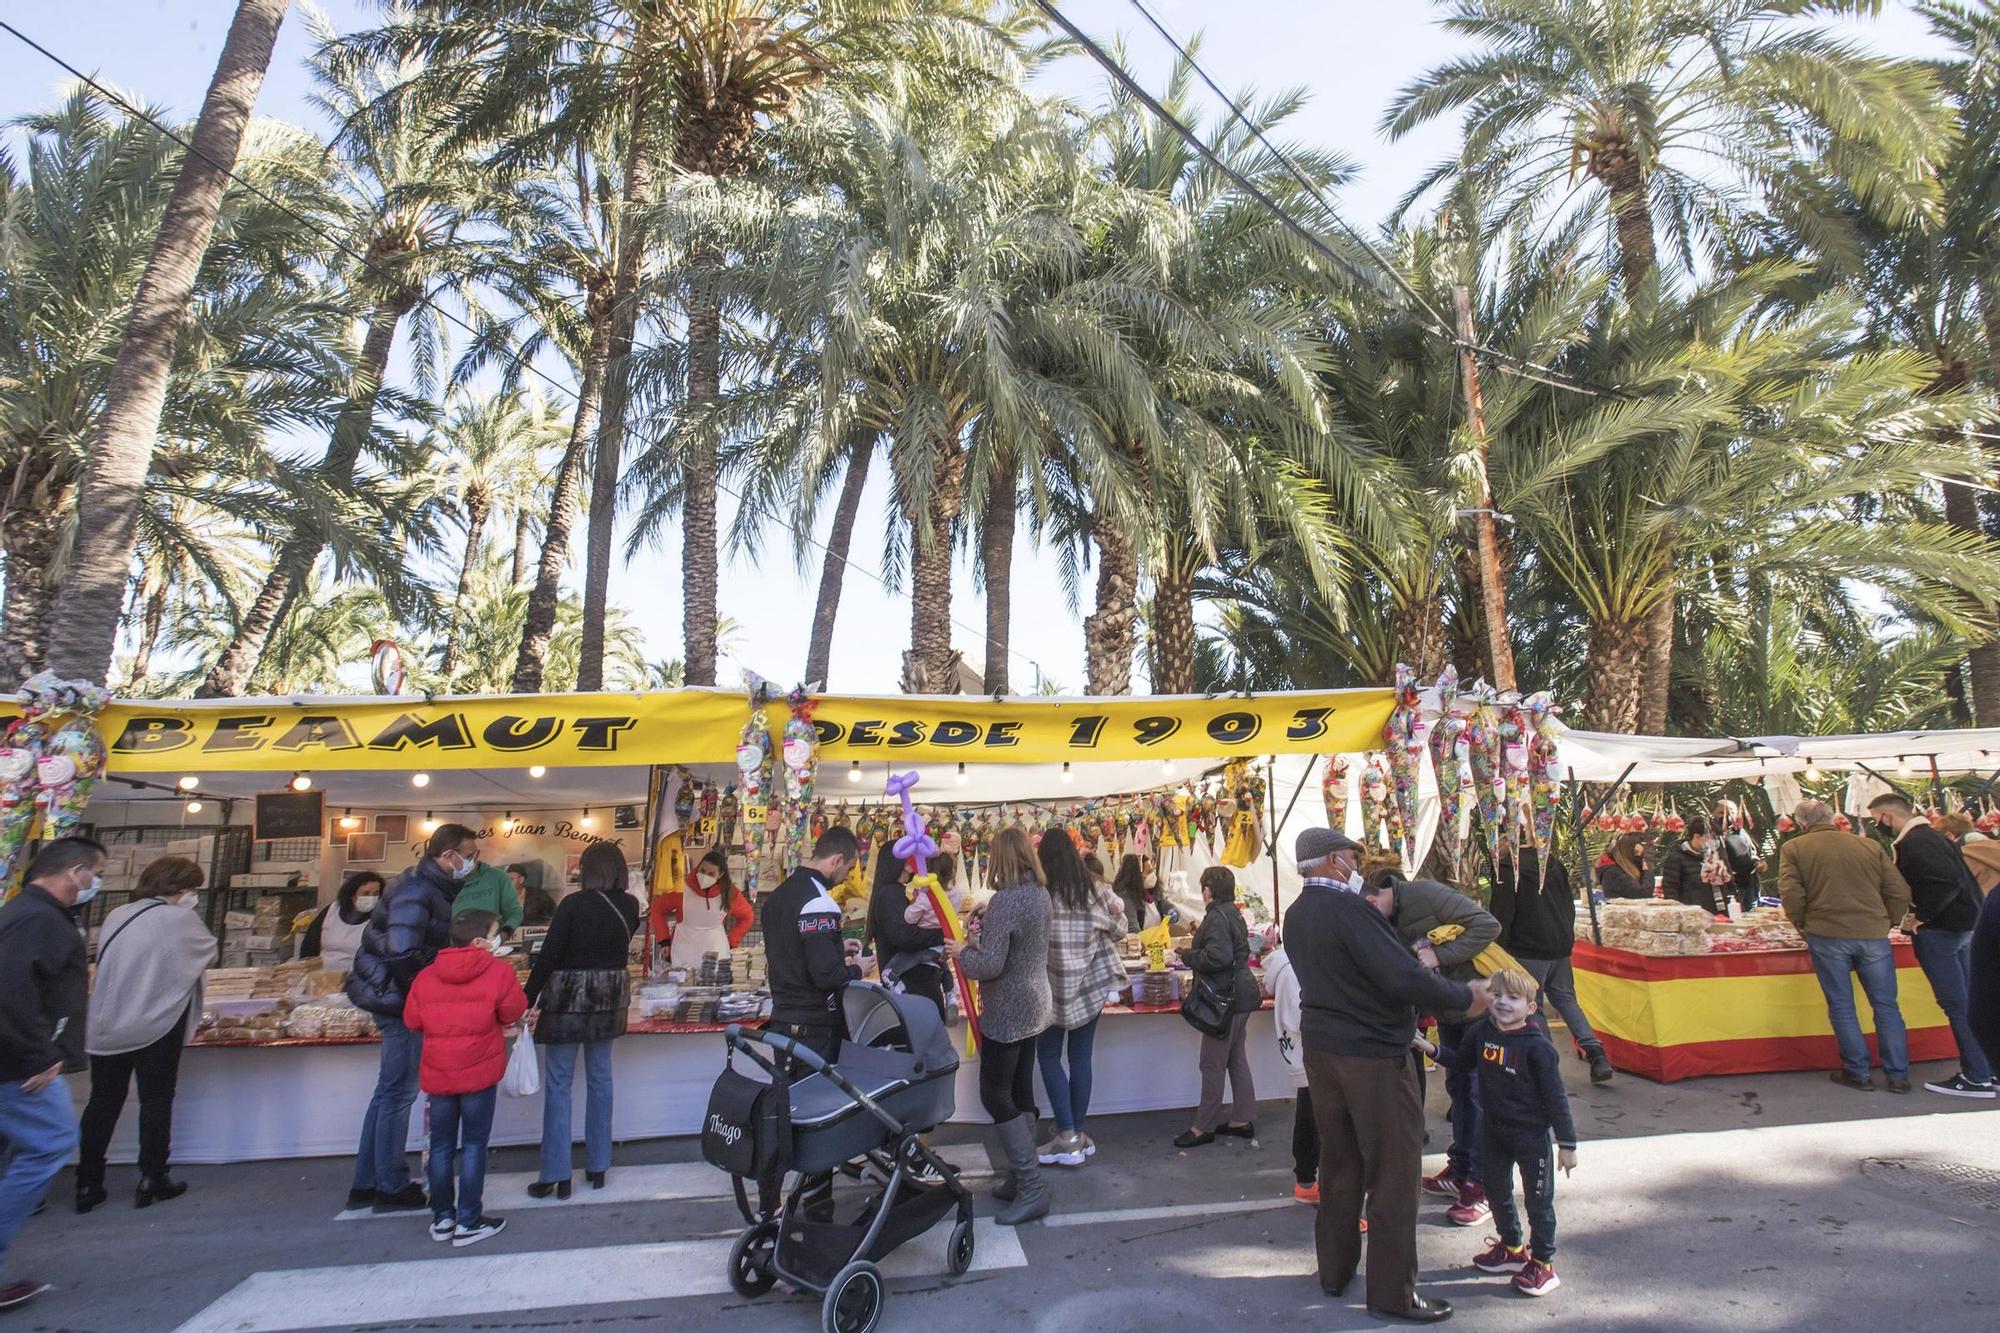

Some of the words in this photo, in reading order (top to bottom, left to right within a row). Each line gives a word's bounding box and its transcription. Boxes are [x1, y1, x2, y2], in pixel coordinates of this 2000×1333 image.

[112, 712, 639, 753] BEAMUT
[813, 720, 1024, 747] DESDE
[1068, 707, 1336, 748] 1903
[503, 819, 547, 838] Juan
[553, 821, 626, 847] Beamt
[710, 1113, 742, 1145] Thiago
